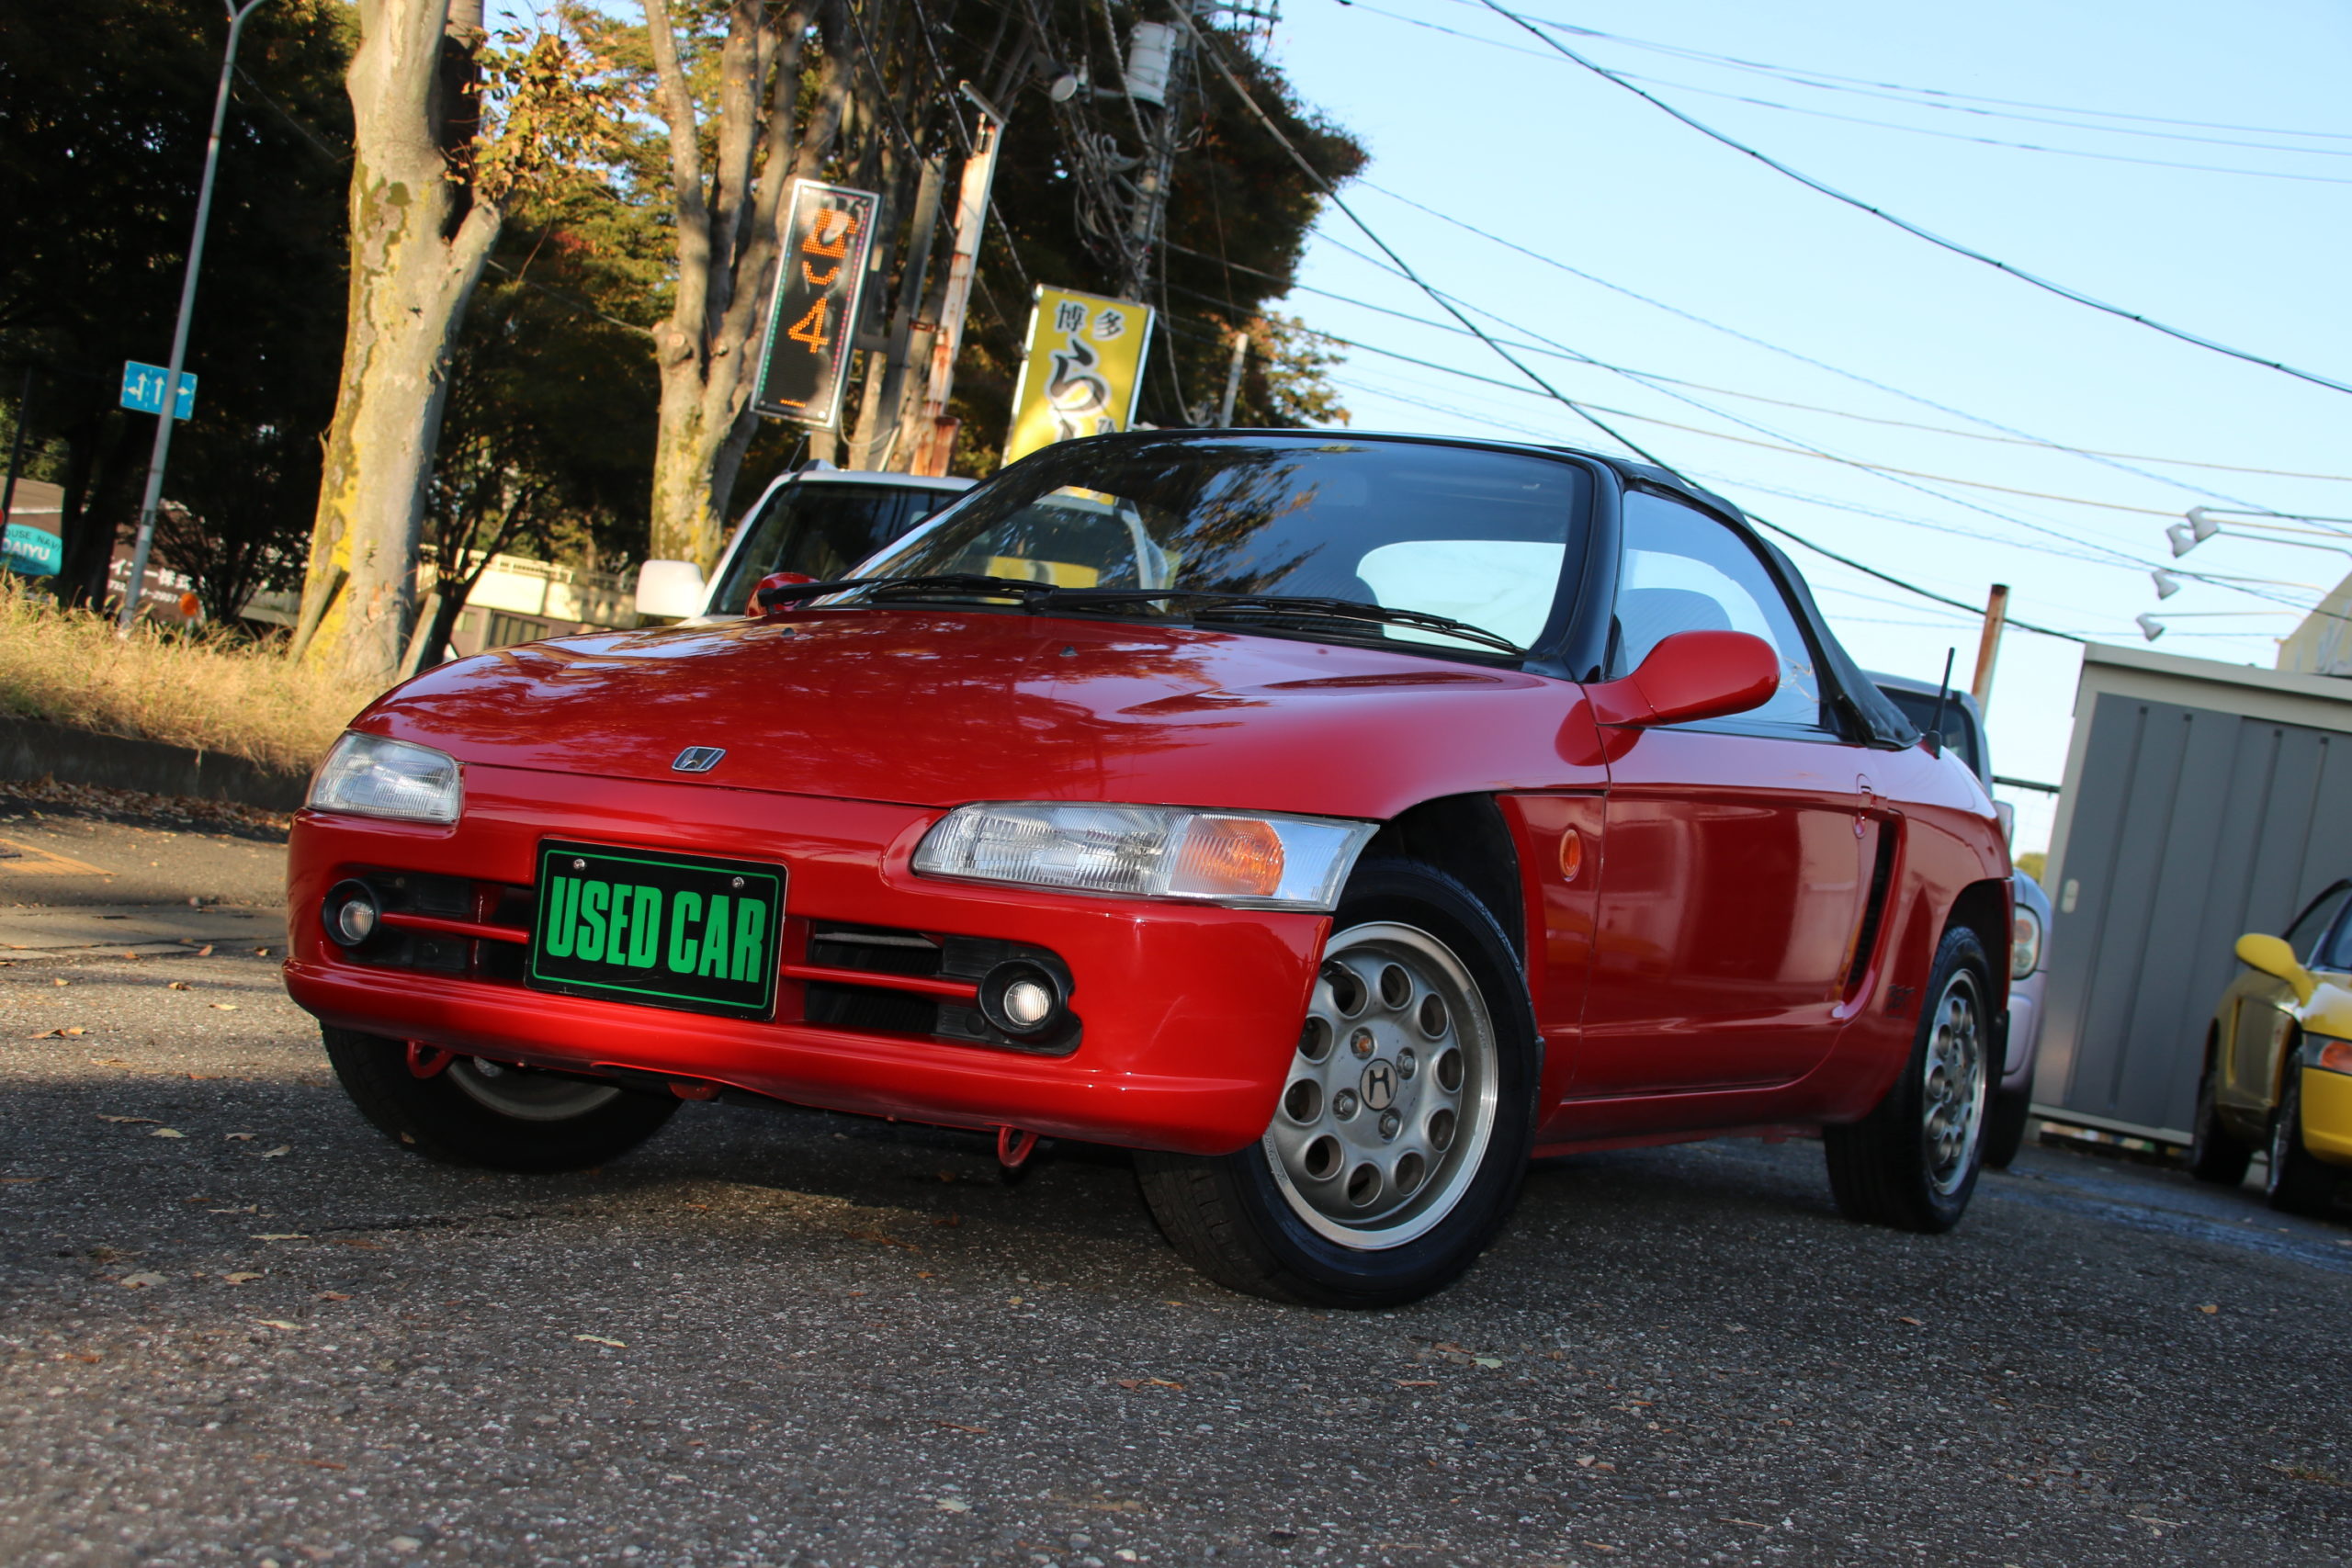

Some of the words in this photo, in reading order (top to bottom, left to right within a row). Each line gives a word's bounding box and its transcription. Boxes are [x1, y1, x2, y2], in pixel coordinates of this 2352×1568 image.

[1057, 304, 1123, 339] 博多
[1050, 339, 1105, 439] ら
[2, 538, 51, 560] DAIYU
[547, 876, 662, 969] USED
[668, 890, 766, 983] CAR
